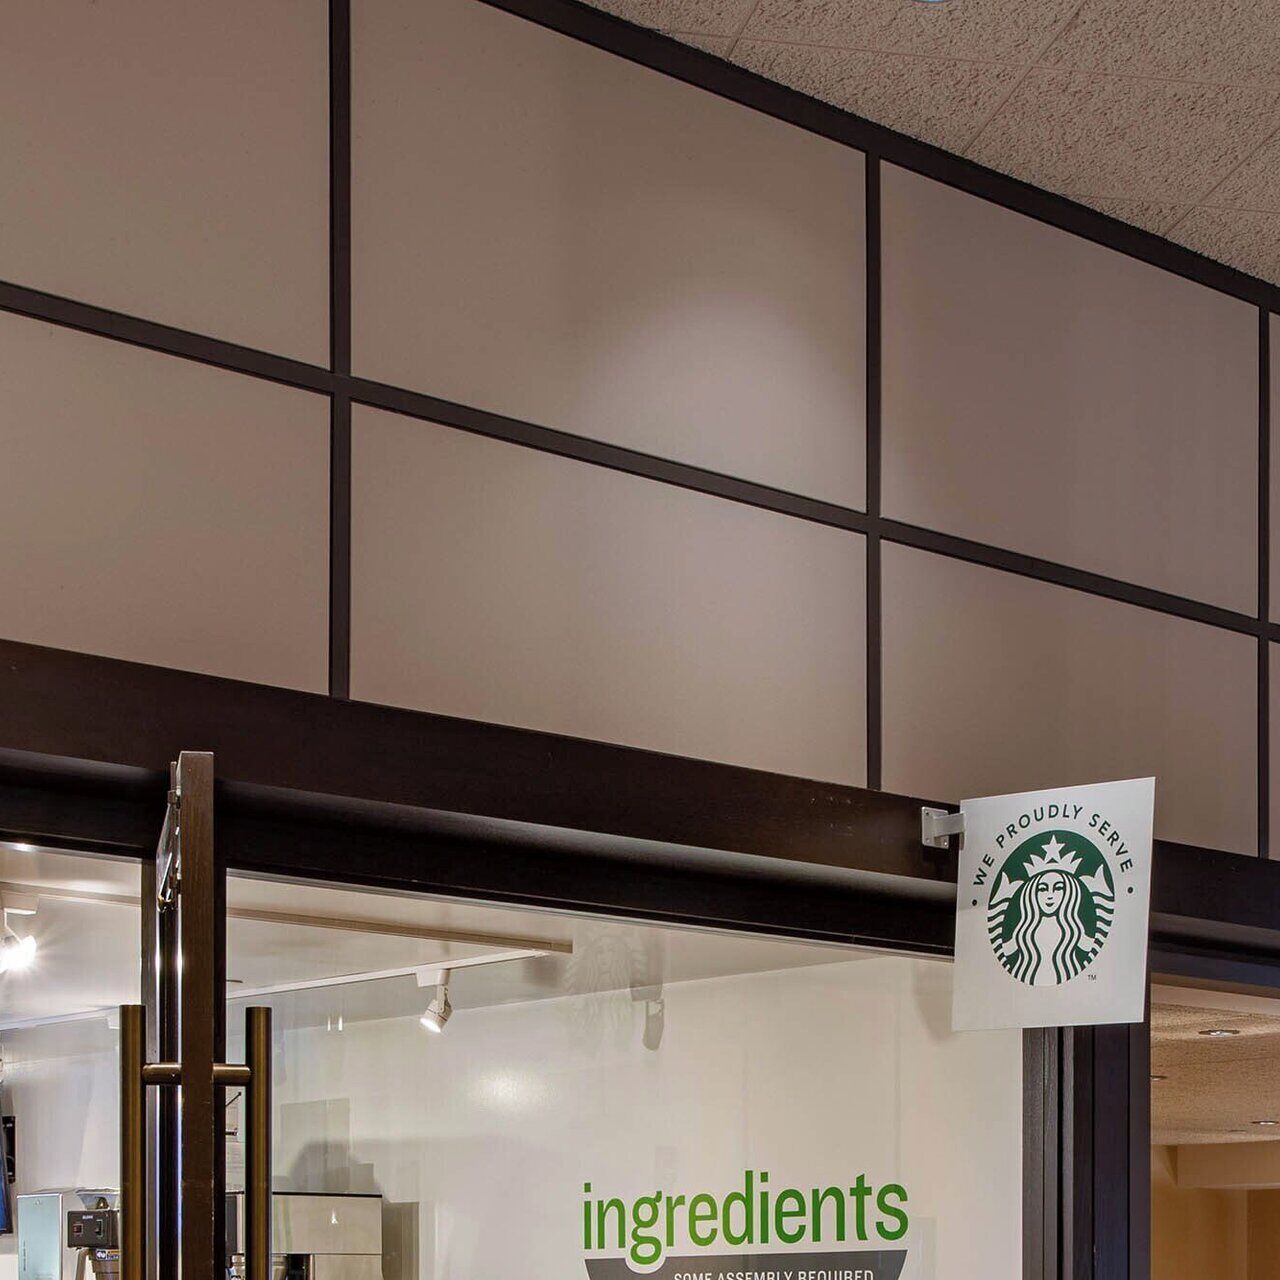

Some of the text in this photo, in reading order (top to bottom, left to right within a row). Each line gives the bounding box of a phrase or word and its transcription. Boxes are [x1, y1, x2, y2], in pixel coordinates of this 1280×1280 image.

[973, 803, 1134, 886] WE PROUDLY SERVE
[583, 1169, 909, 1266] ingredients
